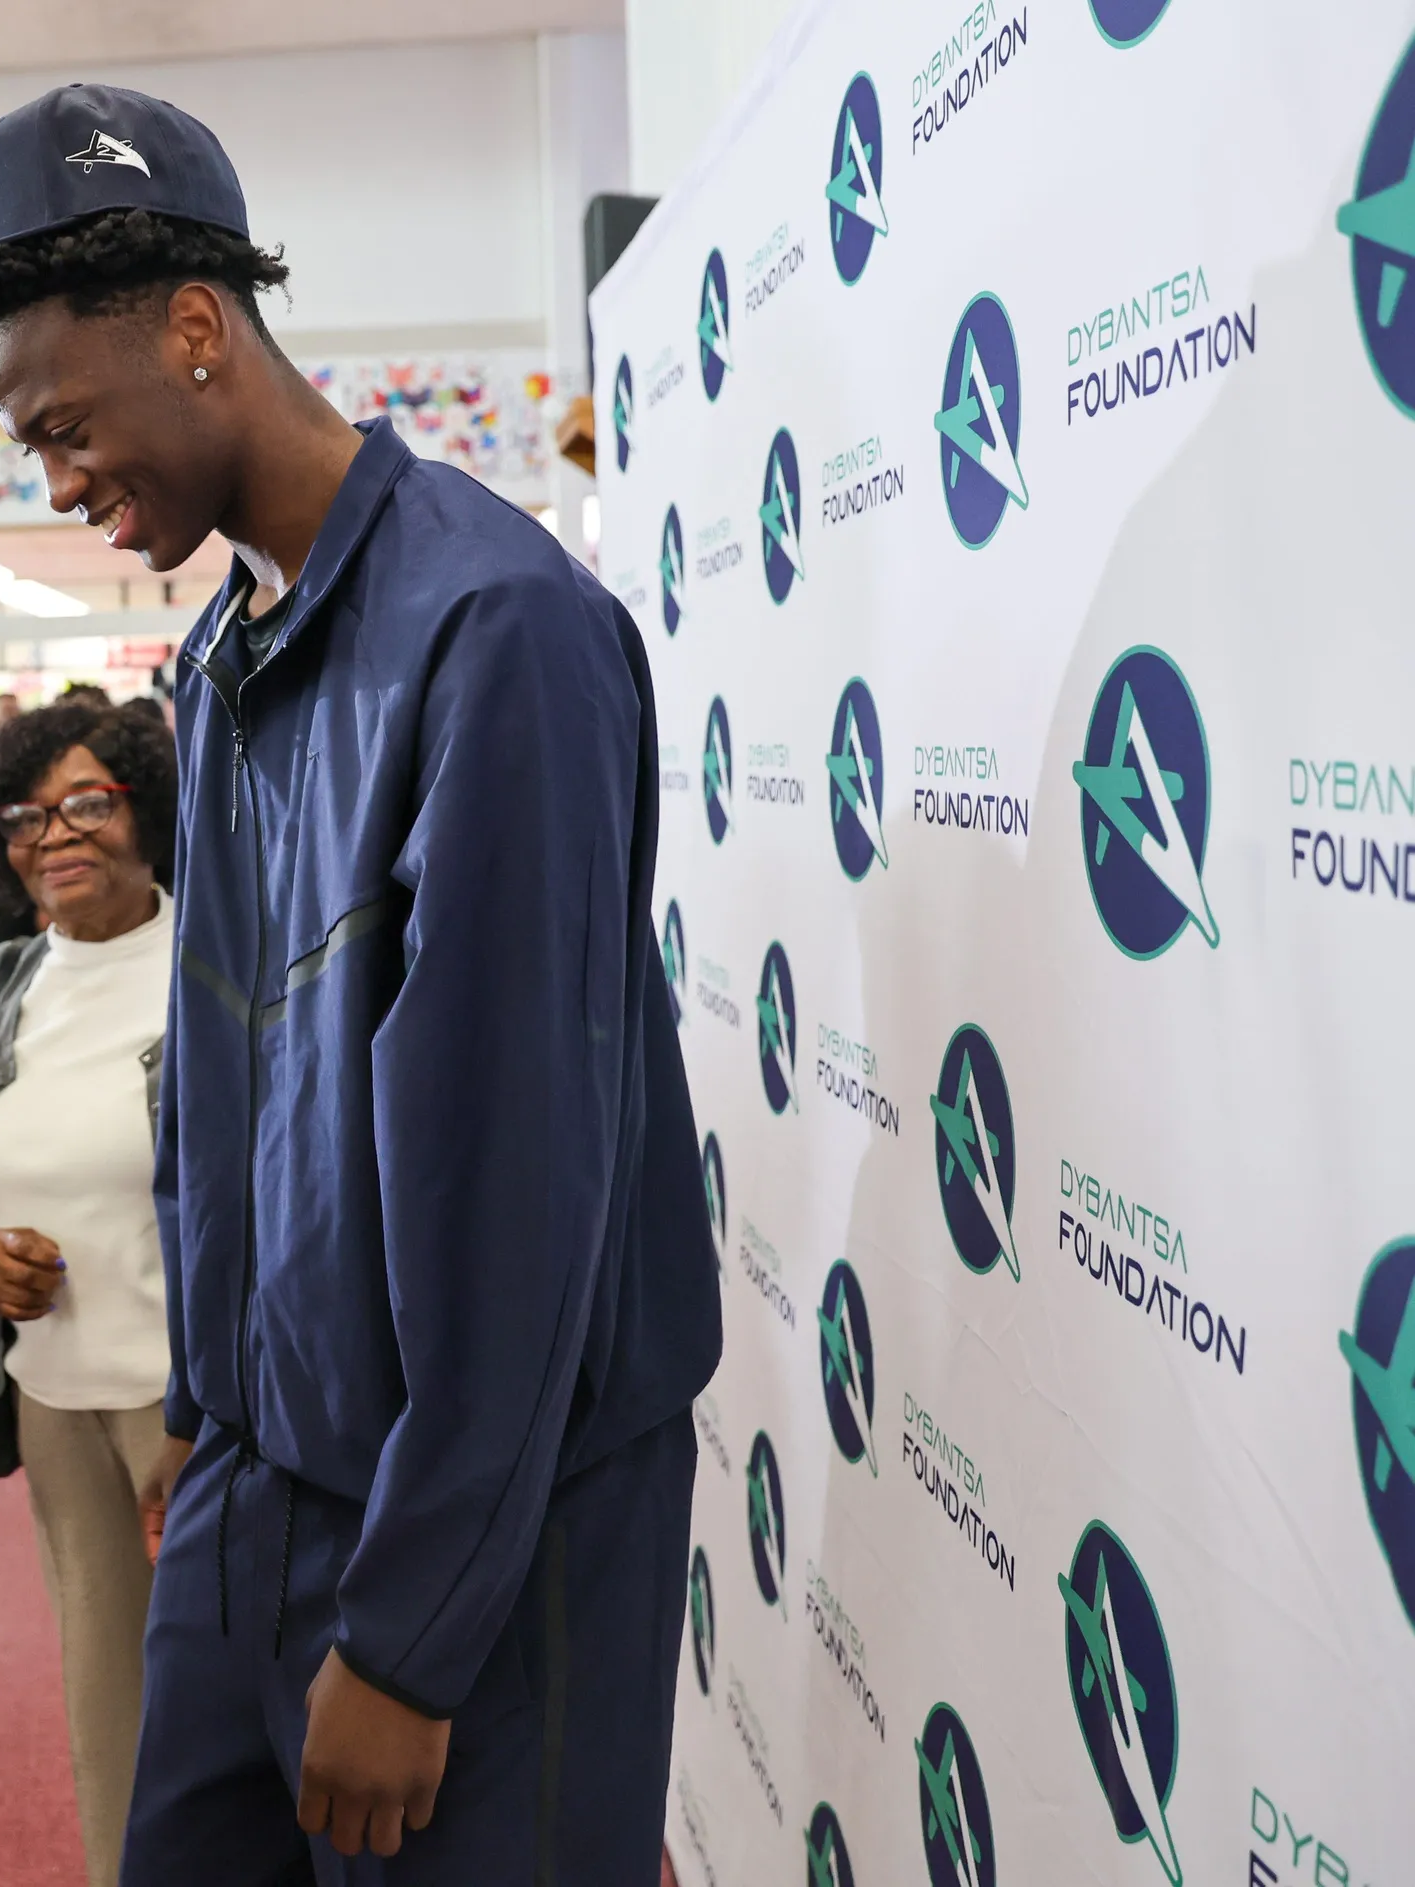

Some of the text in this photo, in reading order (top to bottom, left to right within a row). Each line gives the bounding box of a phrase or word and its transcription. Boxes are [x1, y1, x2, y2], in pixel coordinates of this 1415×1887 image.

[912, 6, 1027, 156] FOUNDATION
[913, 0, 996, 107] DYBANTSA
[1067, 302, 1256, 427] FOUNDATION
[1068, 264, 1210, 367] DYBANTSA
[822, 434, 883, 488] DYBANTSA
[822, 464, 904, 528] FOUNDATION
[913, 788, 1029, 838] FOUNDATION
[914, 745, 999, 780] DYBANTSA
[816, 1056, 900, 1138] FOUNDATION
[817, 1022, 879, 1082] DYBANTSA
[1060, 1158, 1188, 1275] DYBANTSA
[1059, 1210, 1246, 1376] FOUNDATION
[903, 1391, 986, 1508] DYBANTSA
[902, 1431, 1016, 1593] FOUNDATION
